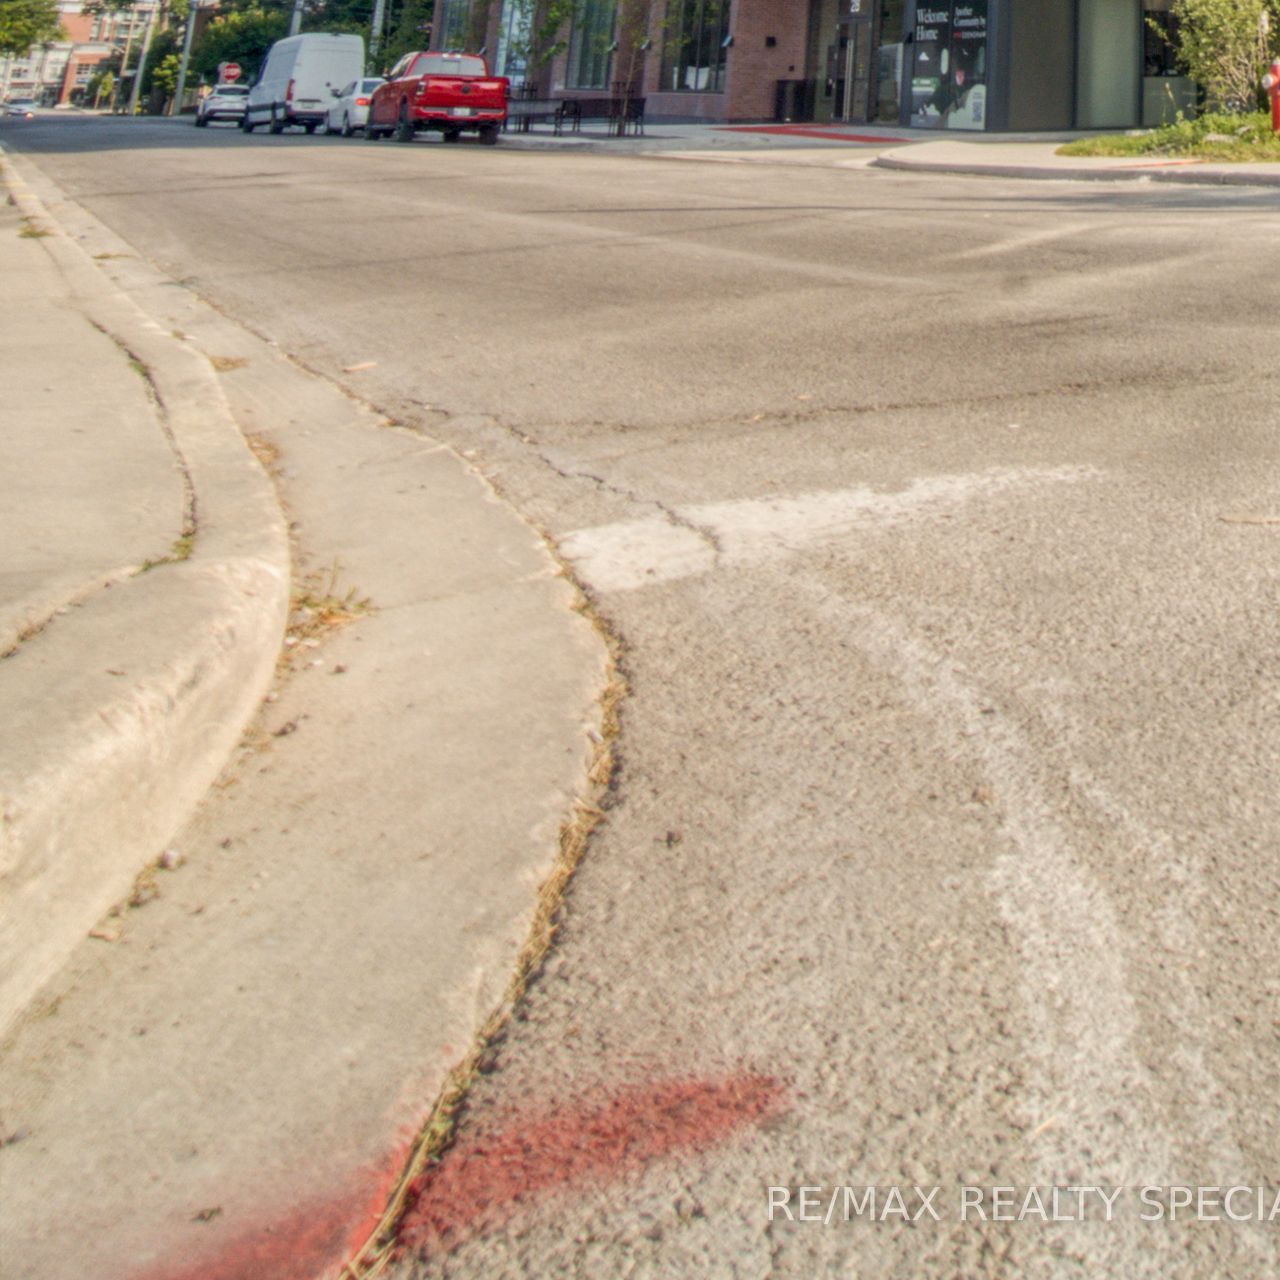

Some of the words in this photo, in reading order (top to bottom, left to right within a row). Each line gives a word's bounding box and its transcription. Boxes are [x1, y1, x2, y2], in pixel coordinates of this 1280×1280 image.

[916, 8, 949, 25] Welcome
[916, 25, 939, 41] Home
[223, 67, 241, 76] STOP
